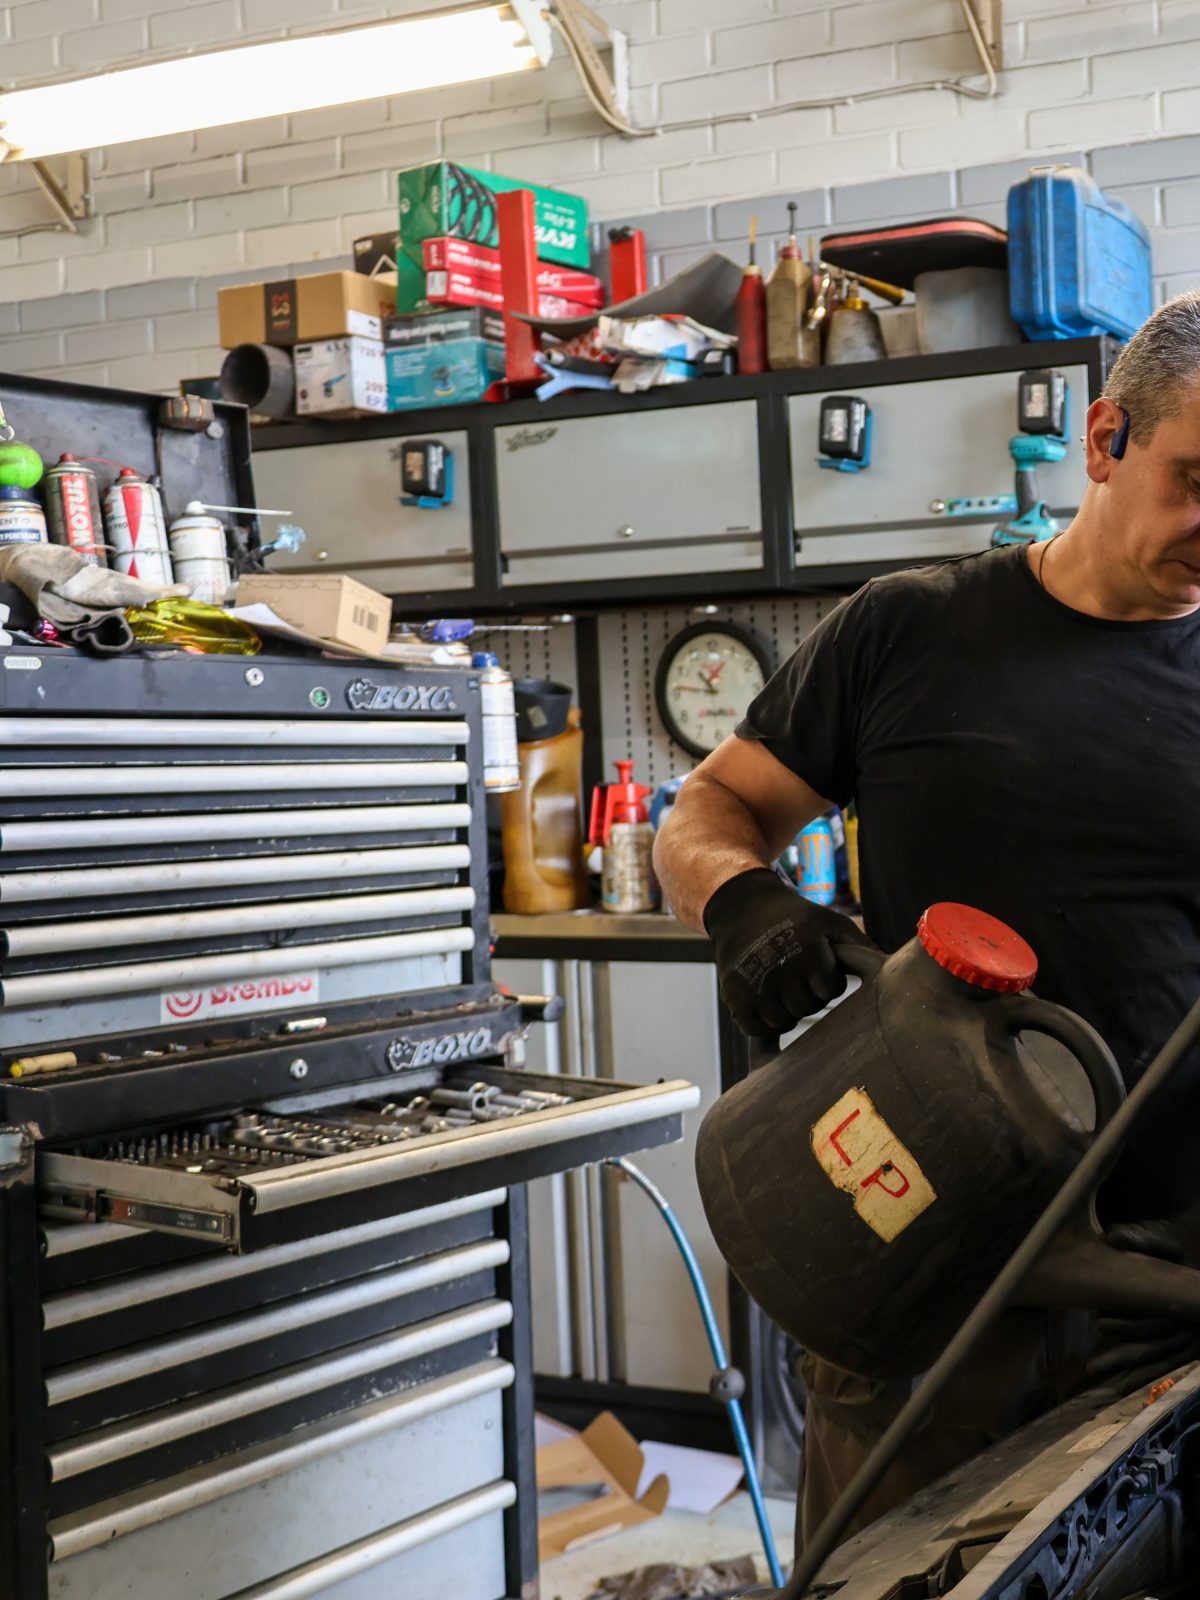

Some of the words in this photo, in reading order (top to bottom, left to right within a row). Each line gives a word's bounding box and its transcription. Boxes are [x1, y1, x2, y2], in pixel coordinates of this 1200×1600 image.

[66, 475, 93, 545] MOTUL
[371, 685, 452, 710] BOXO
[411, 1026, 492, 1068] BOXO
[829, 1108, 910, 1198] LP
